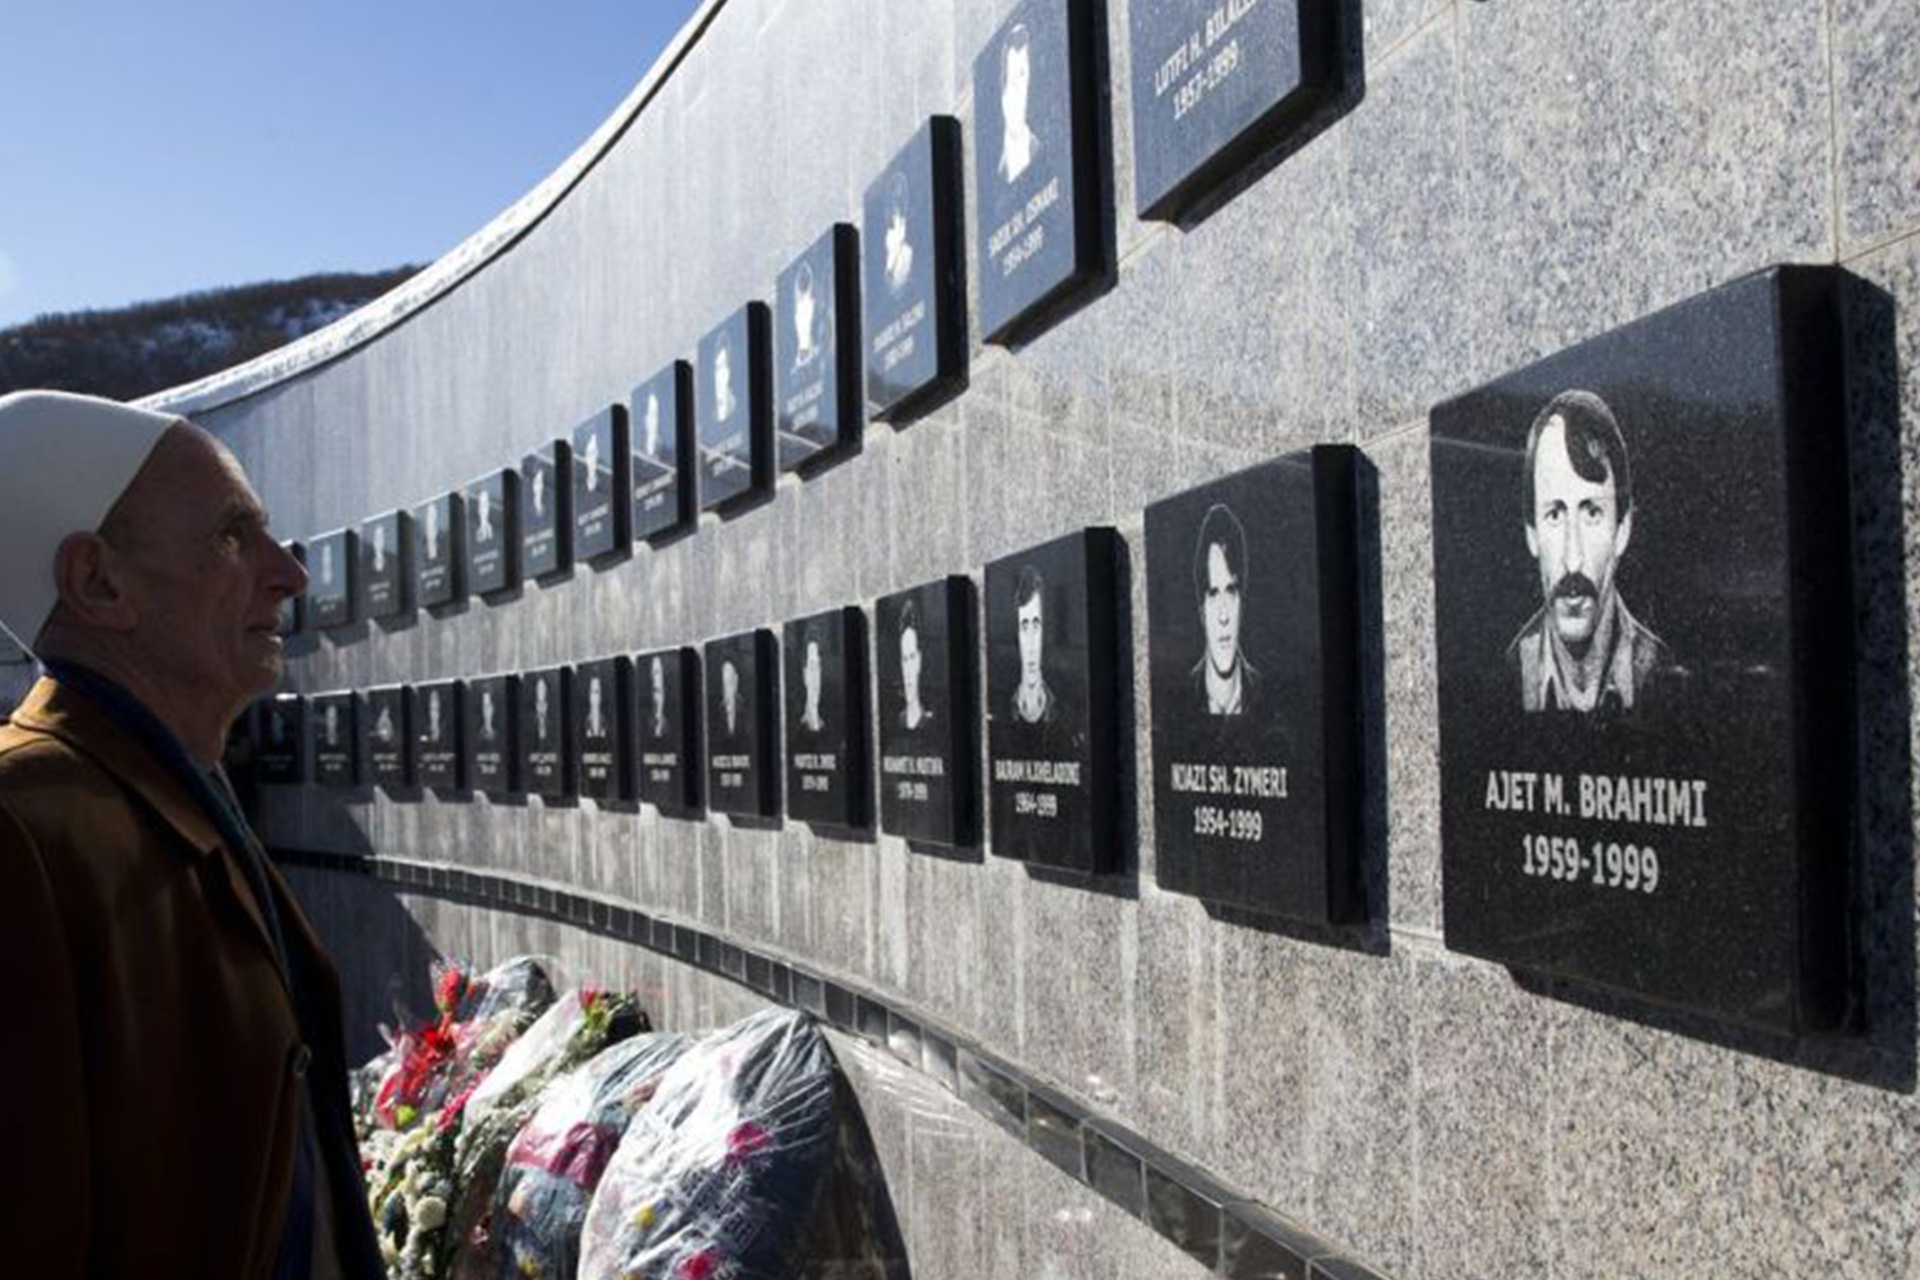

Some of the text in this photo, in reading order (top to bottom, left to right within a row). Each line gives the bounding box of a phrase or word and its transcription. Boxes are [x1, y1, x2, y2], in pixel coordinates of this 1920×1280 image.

[1233, 765, 1288, 798] ZYMERI
[1485, 770, 1708, 827] AJET M. BRAHIMI
[1194, 805, 1263, 842] 1954-1999
[1522, 833, 1660, 893] 1959-1999
